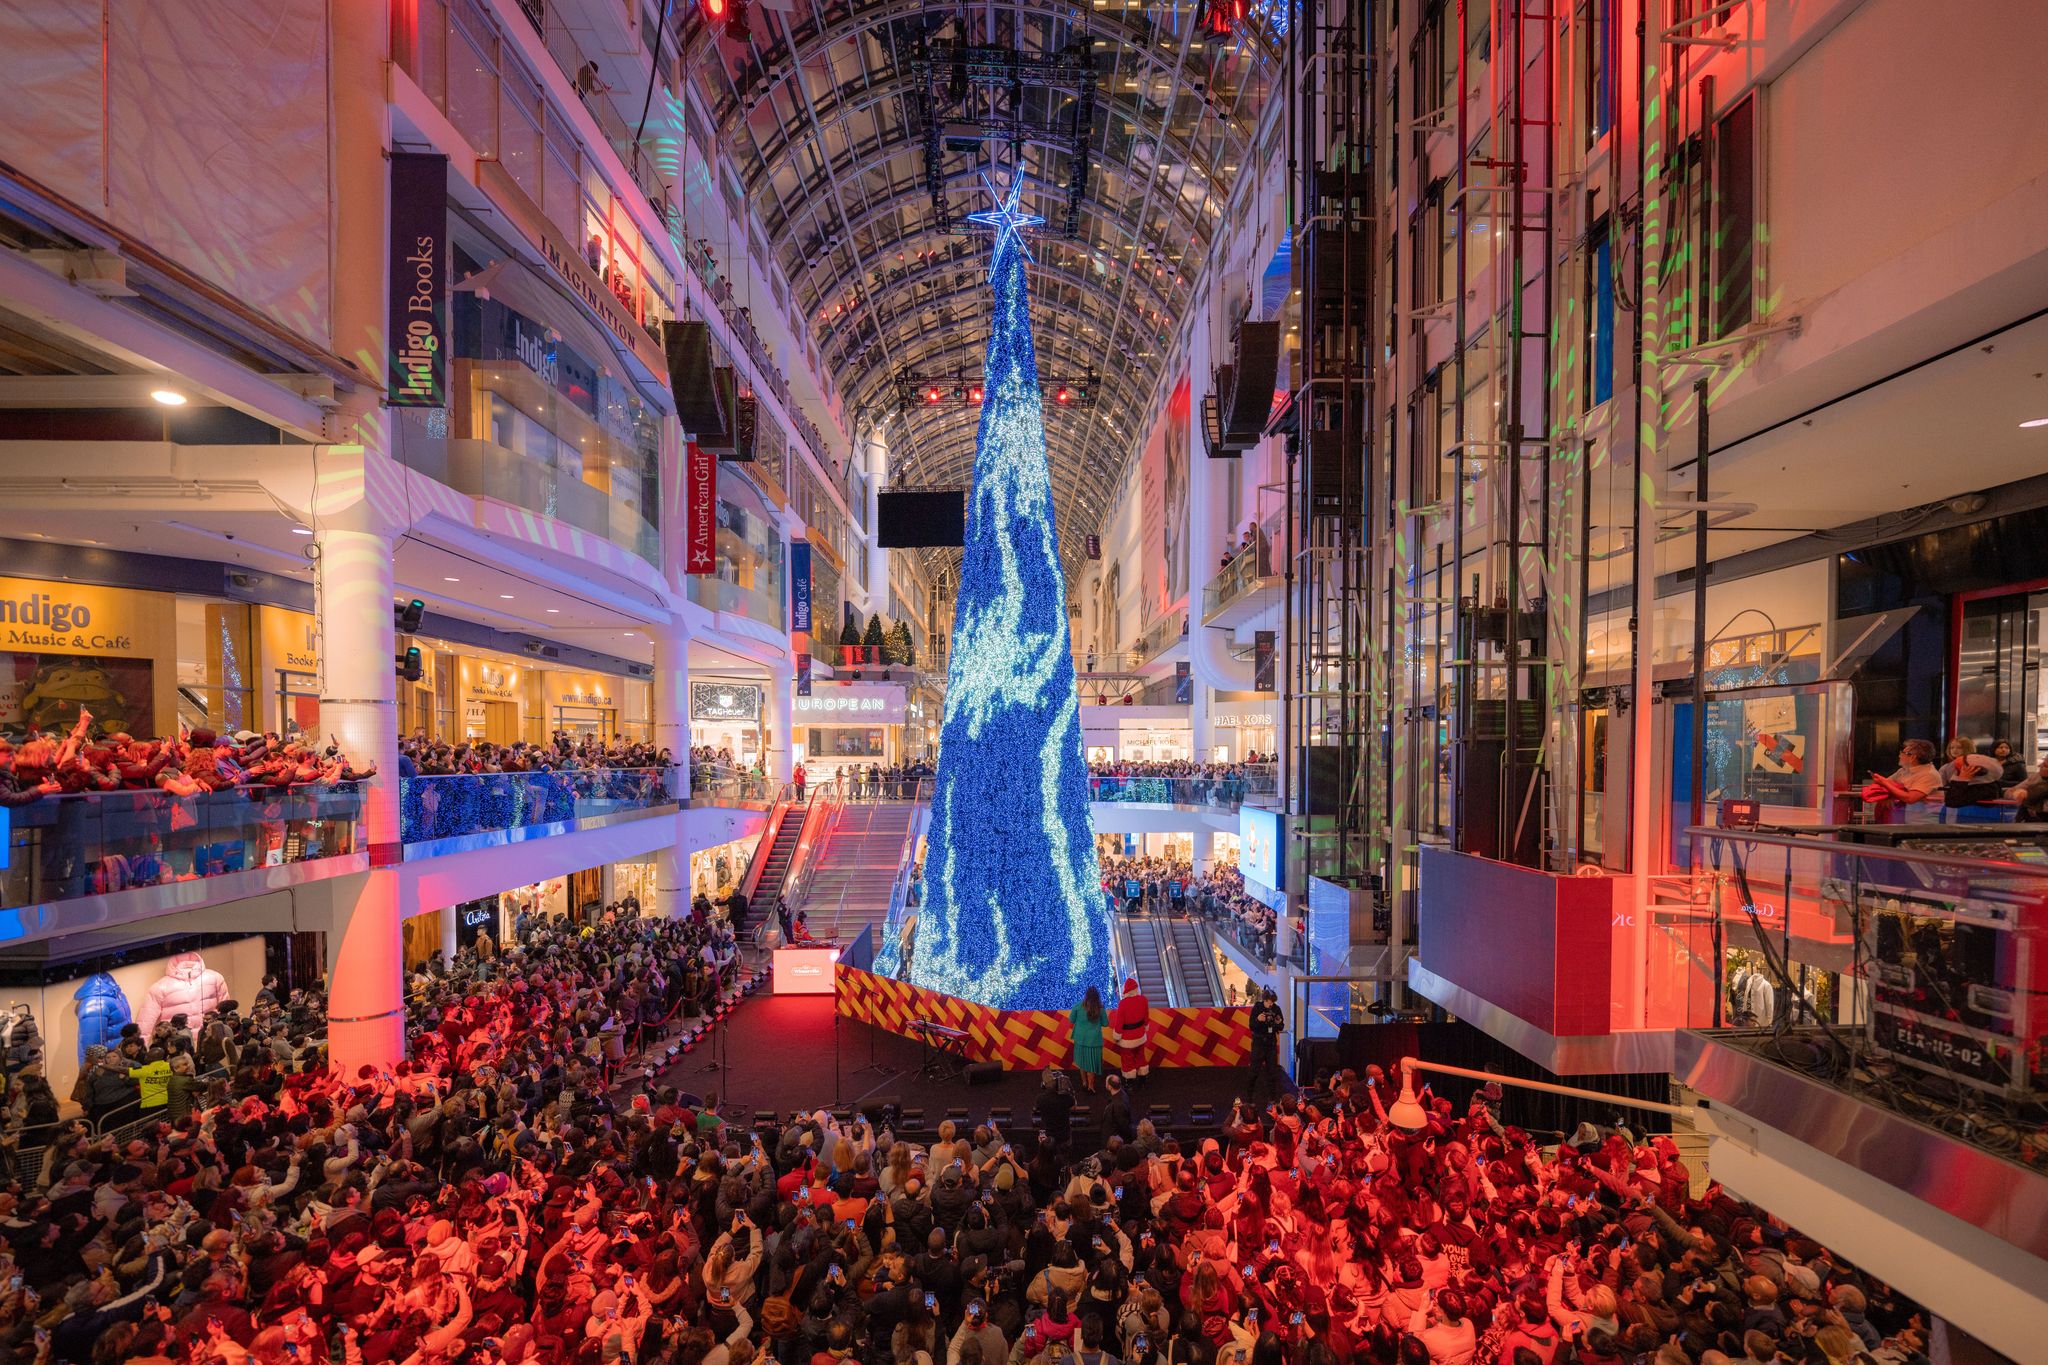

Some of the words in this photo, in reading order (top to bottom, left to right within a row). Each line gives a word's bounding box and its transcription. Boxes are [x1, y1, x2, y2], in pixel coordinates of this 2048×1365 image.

[406, 236, 434, 313] Books
[541, 235, 636, 351] IMAGINATION
[398, 320, 439, 396] Indigo
[515, 319, 559, 386] Indigo
[694, 455, 709, 481] Girl
[694, 483, 709, 548] American
[797, 578, 808, 600] Café
[0, 593, 91, 633] ndigo
[795, 601, 810, 629] Indigo
[8, 630, 66, 647] Music
[71, 635, 91, 650] &
[91, 636, 131, 650] Café
[286, 653, 314, 668] Books
[562, 693, 612, 706] www.indigo.ca
[1215, 715, 1241, 726] HAEL
[1243, 714, 1272, 725] KORS
[1449, 1254, 1467, 1264] OVE
